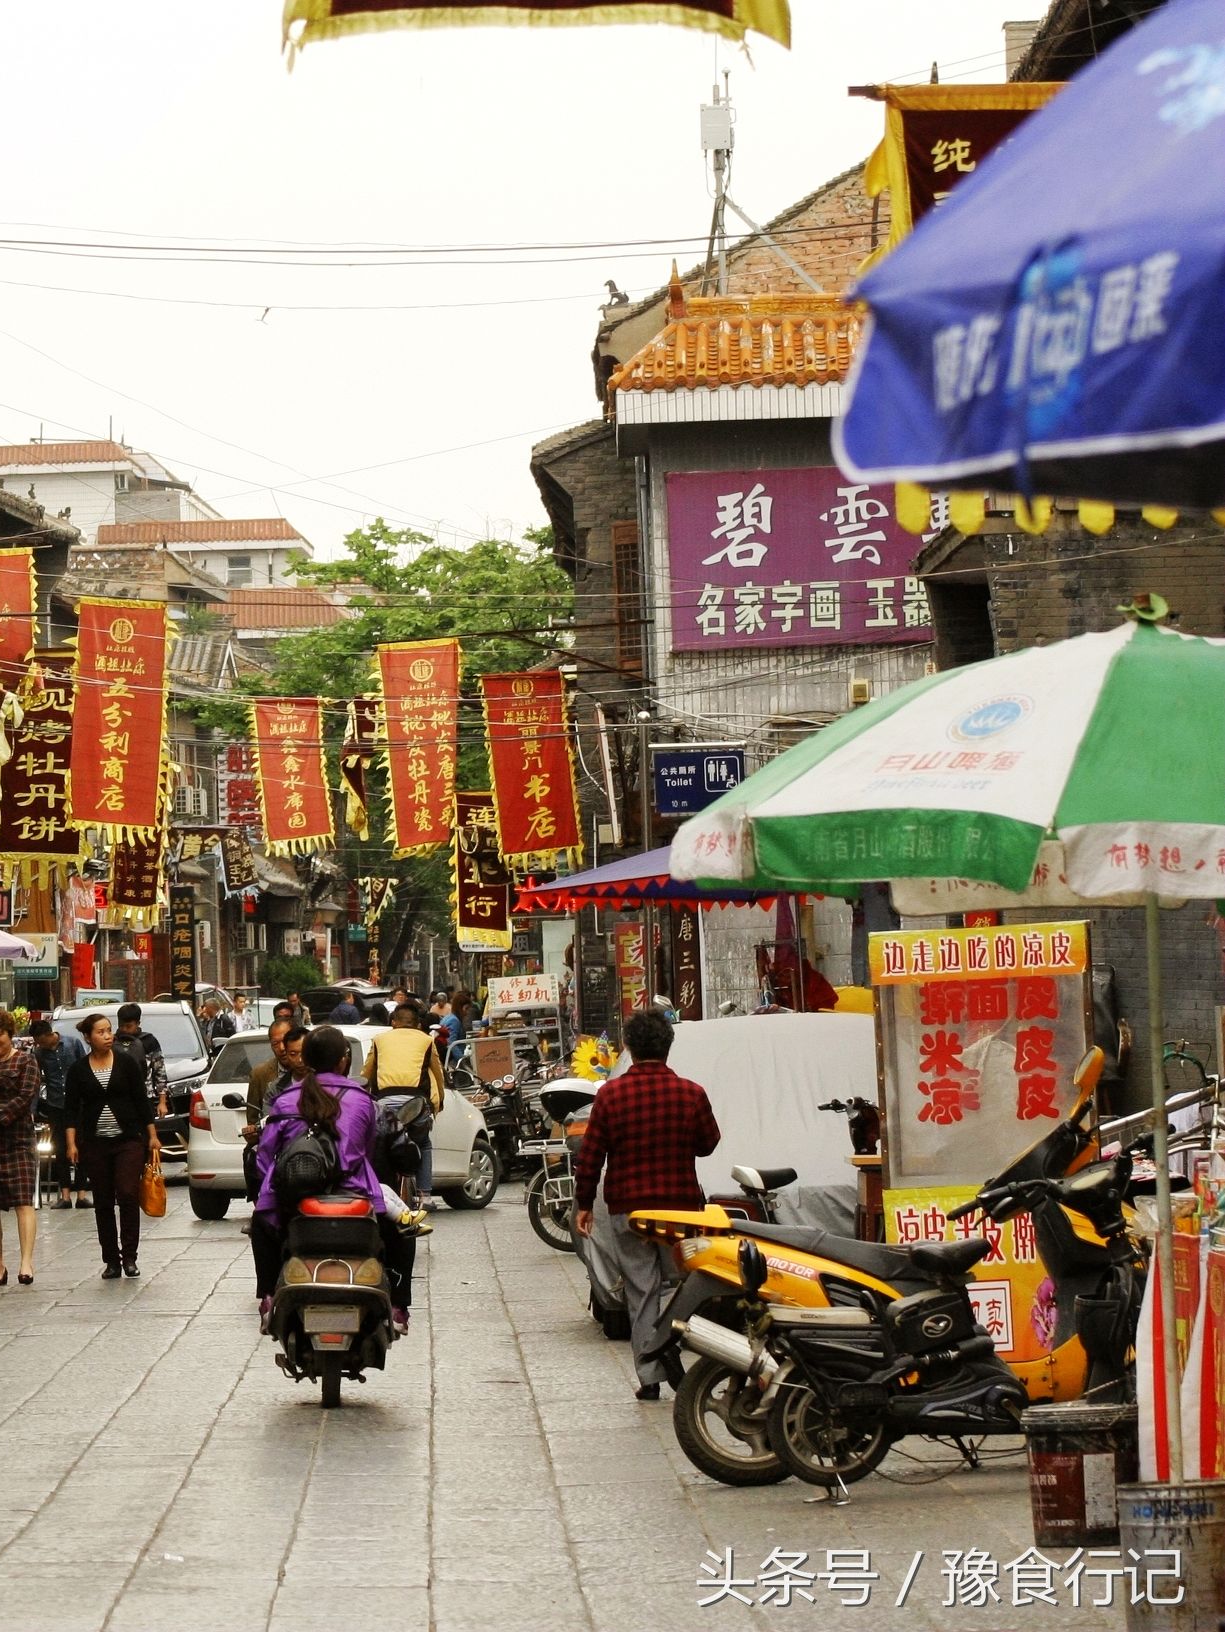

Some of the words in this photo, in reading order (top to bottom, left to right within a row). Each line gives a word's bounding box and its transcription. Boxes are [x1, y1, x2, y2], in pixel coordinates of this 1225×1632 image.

[695, 580, 841, 636] 名家字画
[95, 677, 137, 812] 五分利商店
[400, 714, 432, 833] 批发牡丹瓷
[664, 778, 693, 787] Toilet
[677, 913, 696, 1009] 唐三彩
[882, 931, 1073, 976] 边走边吃的凉皮
[766, 1257, 815, 1278] MOTOR
